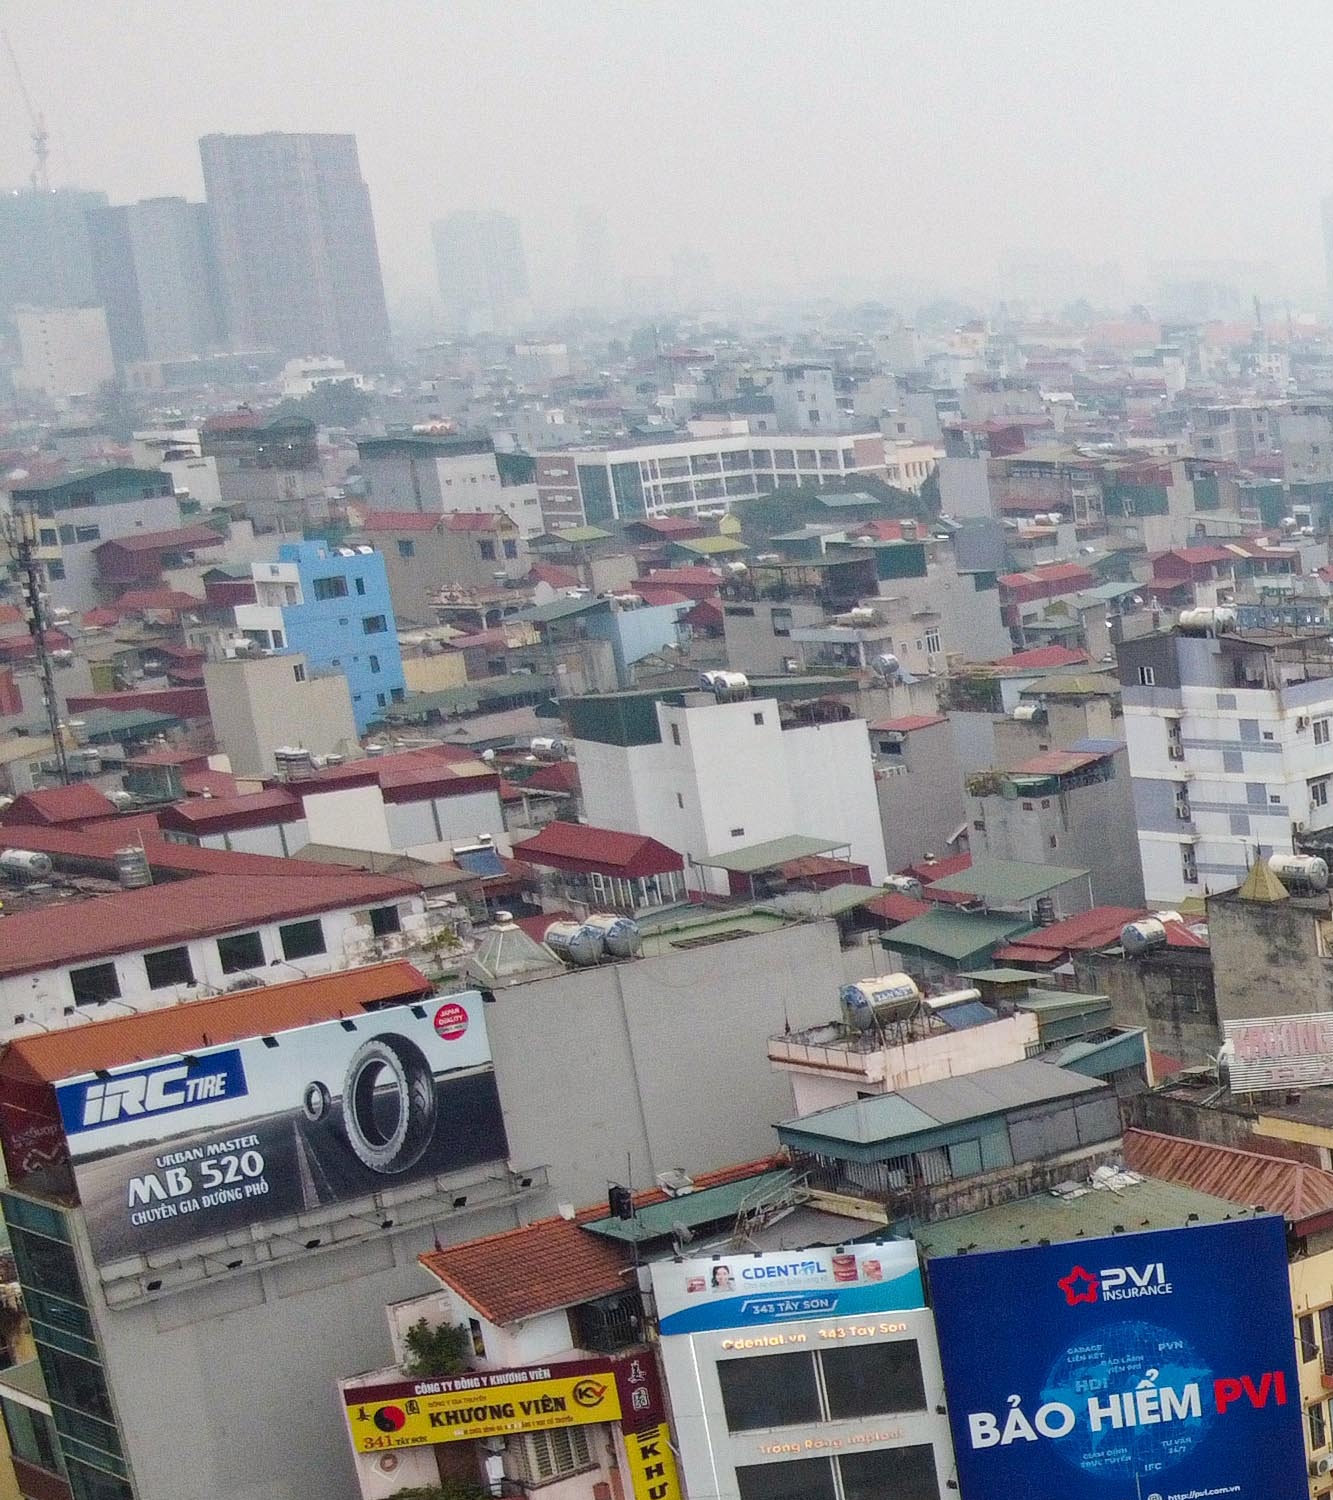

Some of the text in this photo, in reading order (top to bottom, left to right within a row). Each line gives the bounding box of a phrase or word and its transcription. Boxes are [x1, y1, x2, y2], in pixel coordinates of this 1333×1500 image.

[83, 1066, 228, 1126] IRC TIRE
[156, 1134, 260, 1169] URBAN MASTER
[128, 1150, 265, 1208] MB 520
[131, 1177, 269, 1226] CHUYÊN GIA ĐƯỜNG PHỐ
[1100, 1262, 1166, 1291] PVI
[1102, 1283, 1173, 1301] INSURANCE
[752, 1298, 829, 1315] 343 TÂY SƠN
[819, 1328, 846, 1341] 343
[1157, 1341, 1184, 1352] PVN
[414, 1380, 442, 1395] CÔNG
[442, 1380, 454, 1393] TY
[481, 1376, 490, 1388] Y
[490, 1371, 529, 1386] KHƯƠNG
[529, 1367, 551, 1382] VIÊN
[429, 1394, 567, 1428] KHƯƠNG VIÊN
[968, 1368, 1288, 1449] BẢO HIỂM PVI
[363, 1434, 393, 1449] 341
[1144, 1462, 1162, 1472] IFC
